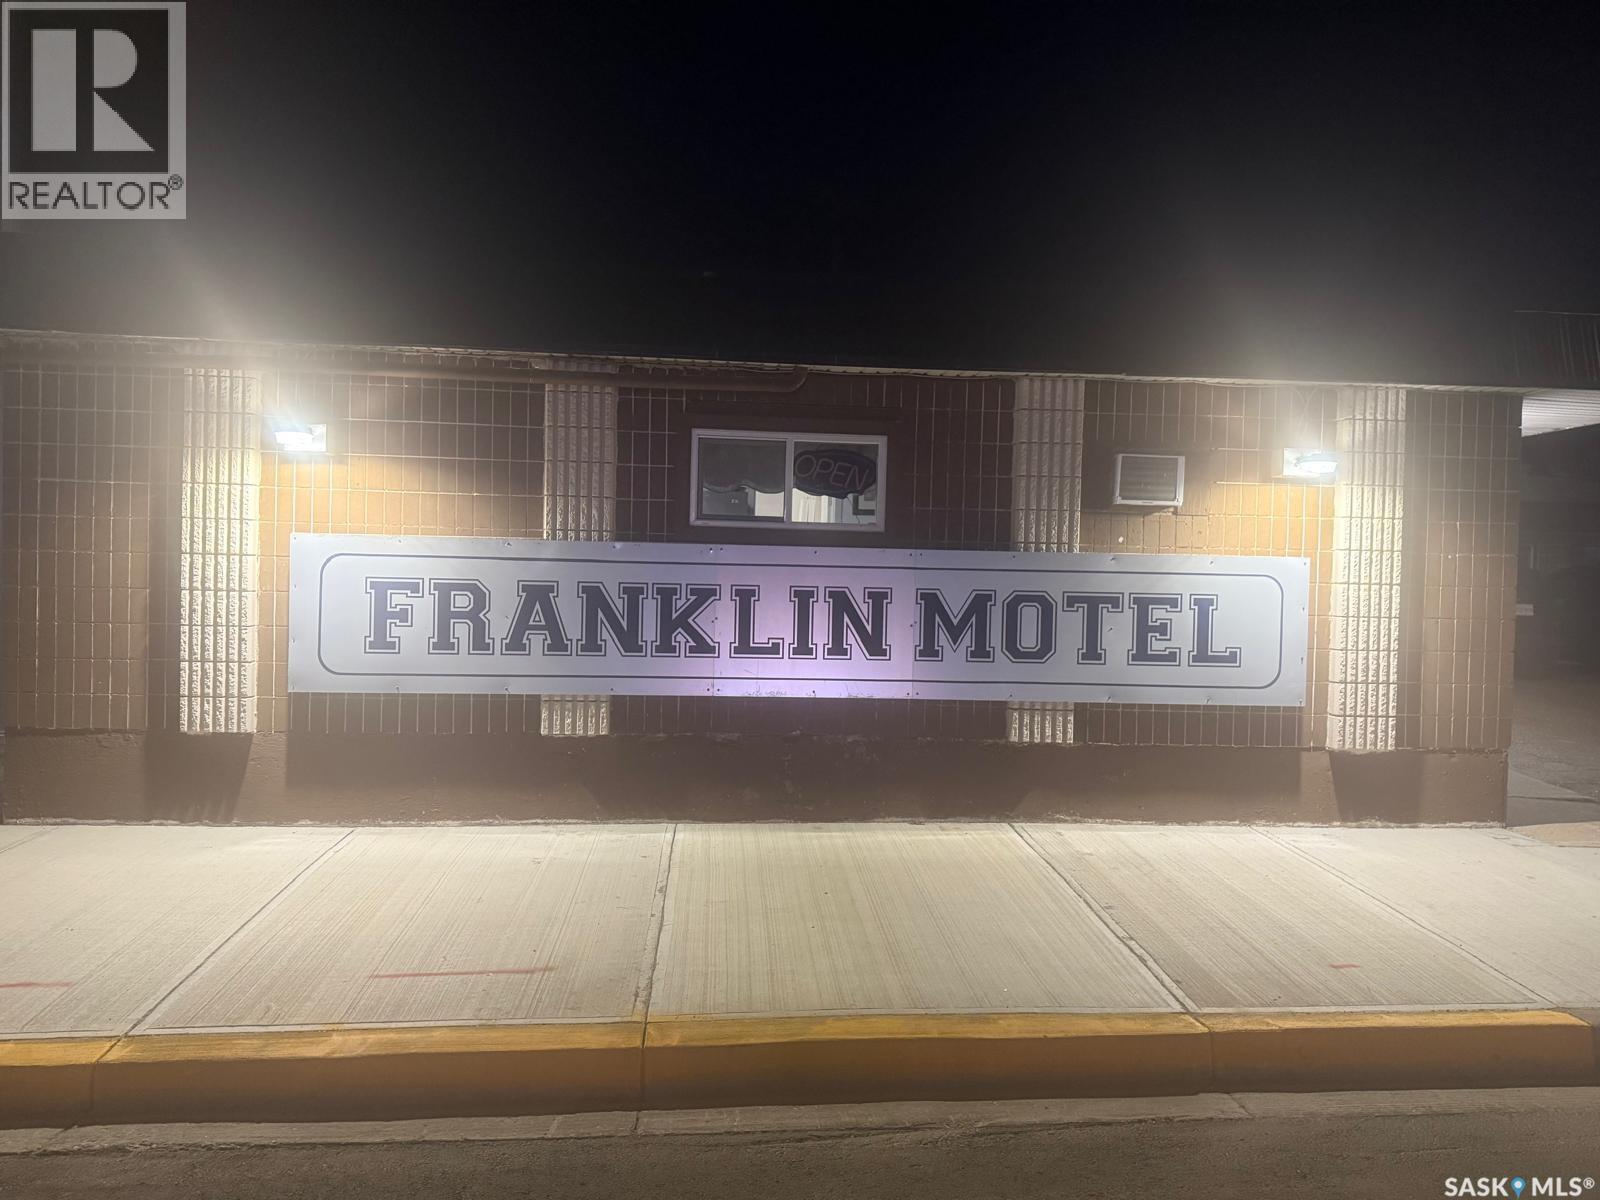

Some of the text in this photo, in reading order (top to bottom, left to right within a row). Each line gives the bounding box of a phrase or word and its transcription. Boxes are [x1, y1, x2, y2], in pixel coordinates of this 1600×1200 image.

[795, 455, 869, 490] OPEN
[364, 576, 1241, 667] FRANKLIN MOTEL
